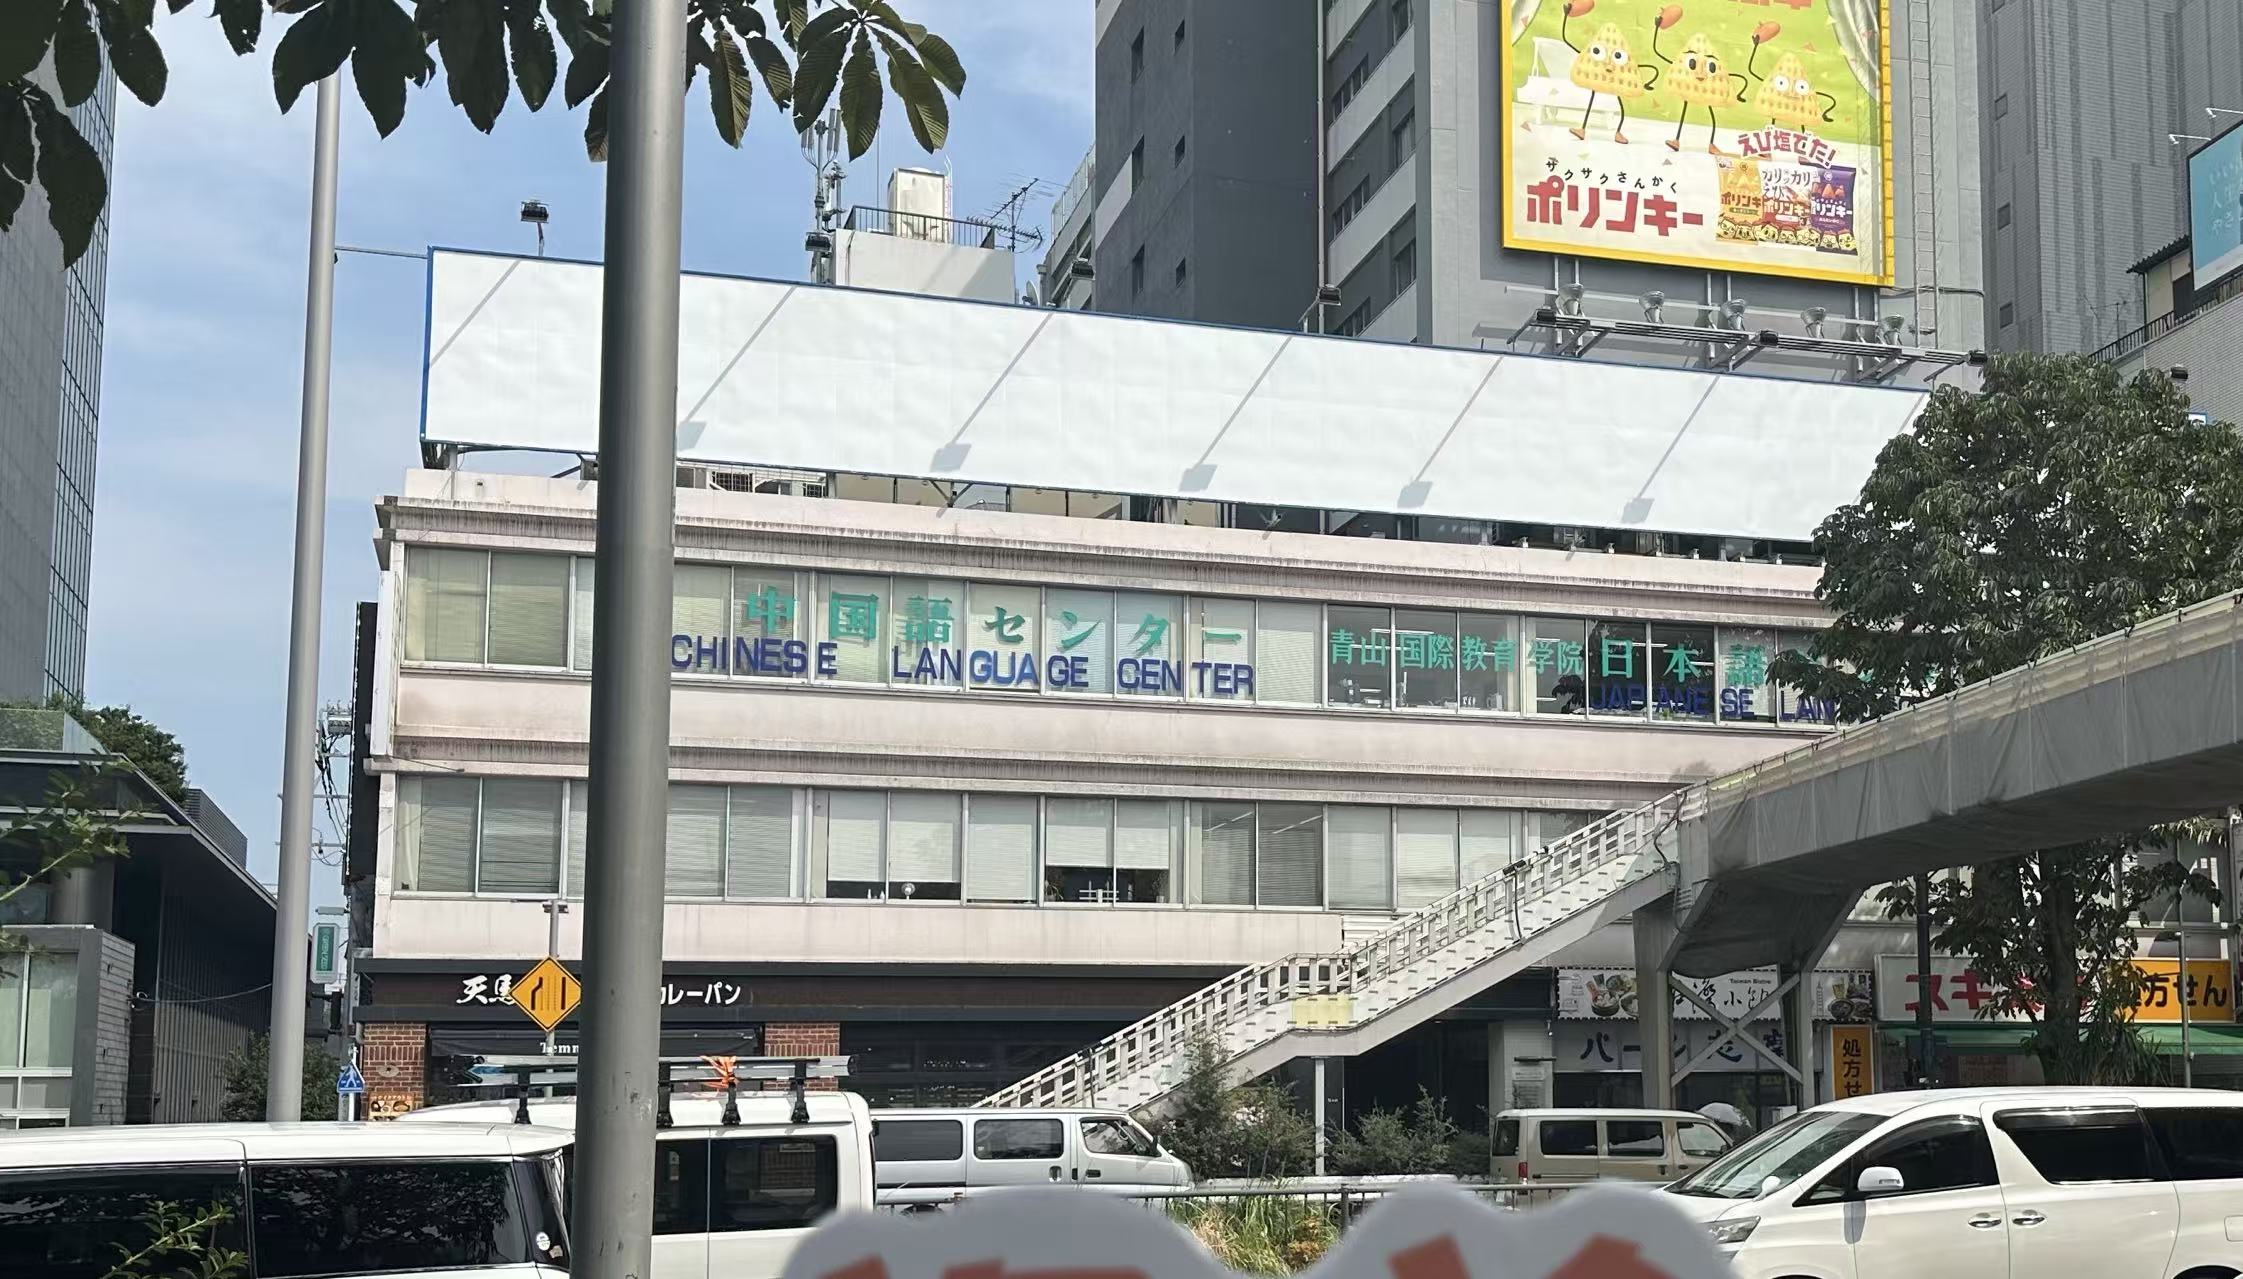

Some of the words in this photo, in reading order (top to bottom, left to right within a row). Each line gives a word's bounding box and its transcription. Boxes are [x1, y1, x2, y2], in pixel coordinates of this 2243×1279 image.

[1527, 175, 1703, 236] ポリンキー
[1721, 192, 1762, 208] ポリンキ
[748, 585, 1242, 657] 中国語センター
[671, 634, 838, 675] CHINESE
[893, 646, 1089, 687] LANGUAGE
[1118, 658, 1254, 694] CENTER
[1330, 629, 1584, 675] 青山国際教育学院
[661, 981, 741, 1006] レーパン
[2135, 973, 2227, 1008] 方せん
